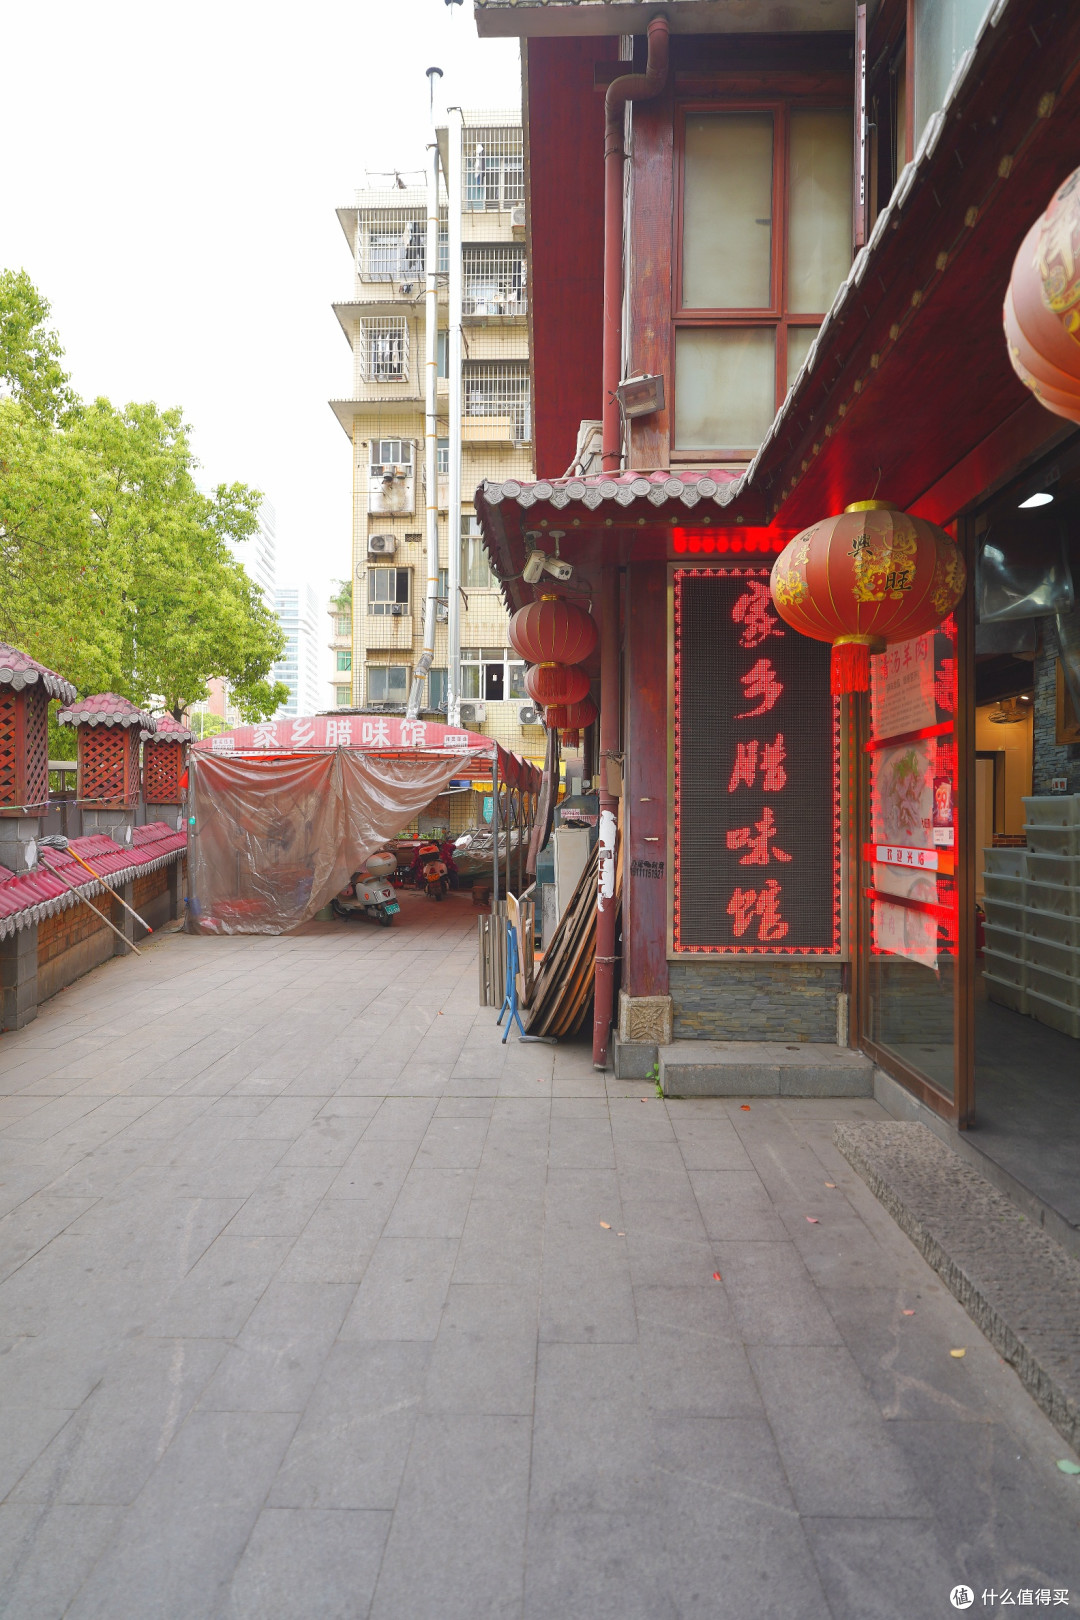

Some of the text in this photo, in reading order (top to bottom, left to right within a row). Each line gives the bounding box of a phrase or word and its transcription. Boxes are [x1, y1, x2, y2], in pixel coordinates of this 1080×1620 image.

[253, 718, 427, 748] 家乡腊味馆
[726, 580, 792, 941] 家乡腊味馆
[887, 848, 925, 866] 欢迎光临
